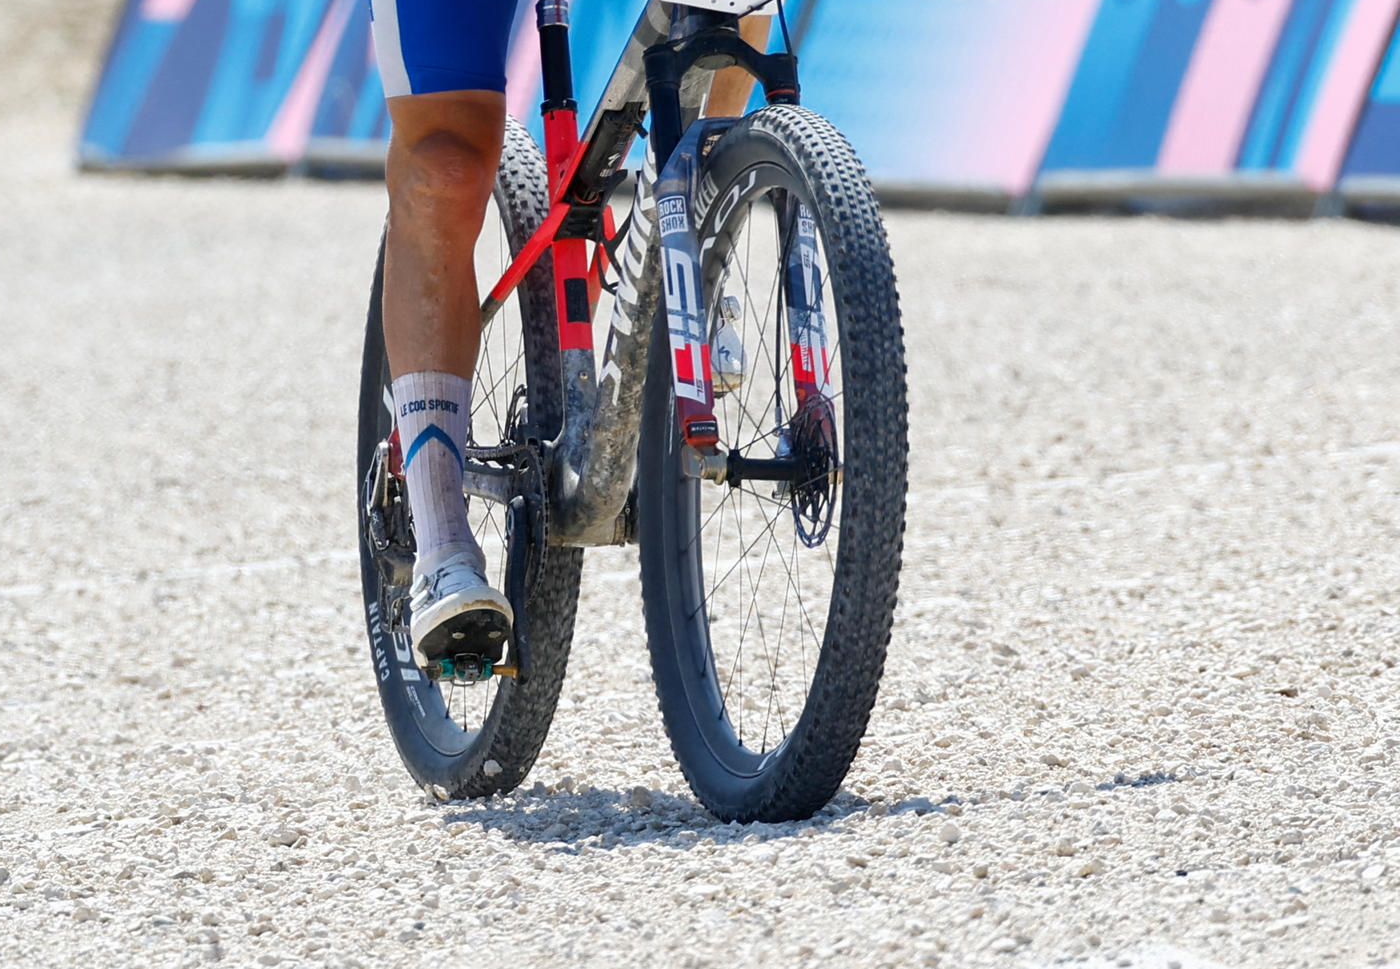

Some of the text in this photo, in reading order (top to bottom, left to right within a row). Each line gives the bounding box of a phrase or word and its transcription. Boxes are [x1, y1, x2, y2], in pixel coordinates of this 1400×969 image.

[659, 199, 683, 218] ROCK
[661, 216, 686, 233] SHOX
[401, 403, 408, 417] LE
[428, 399, 459, 415] SPORTIF
[369, 602, 391, 682] CAPTAIN
